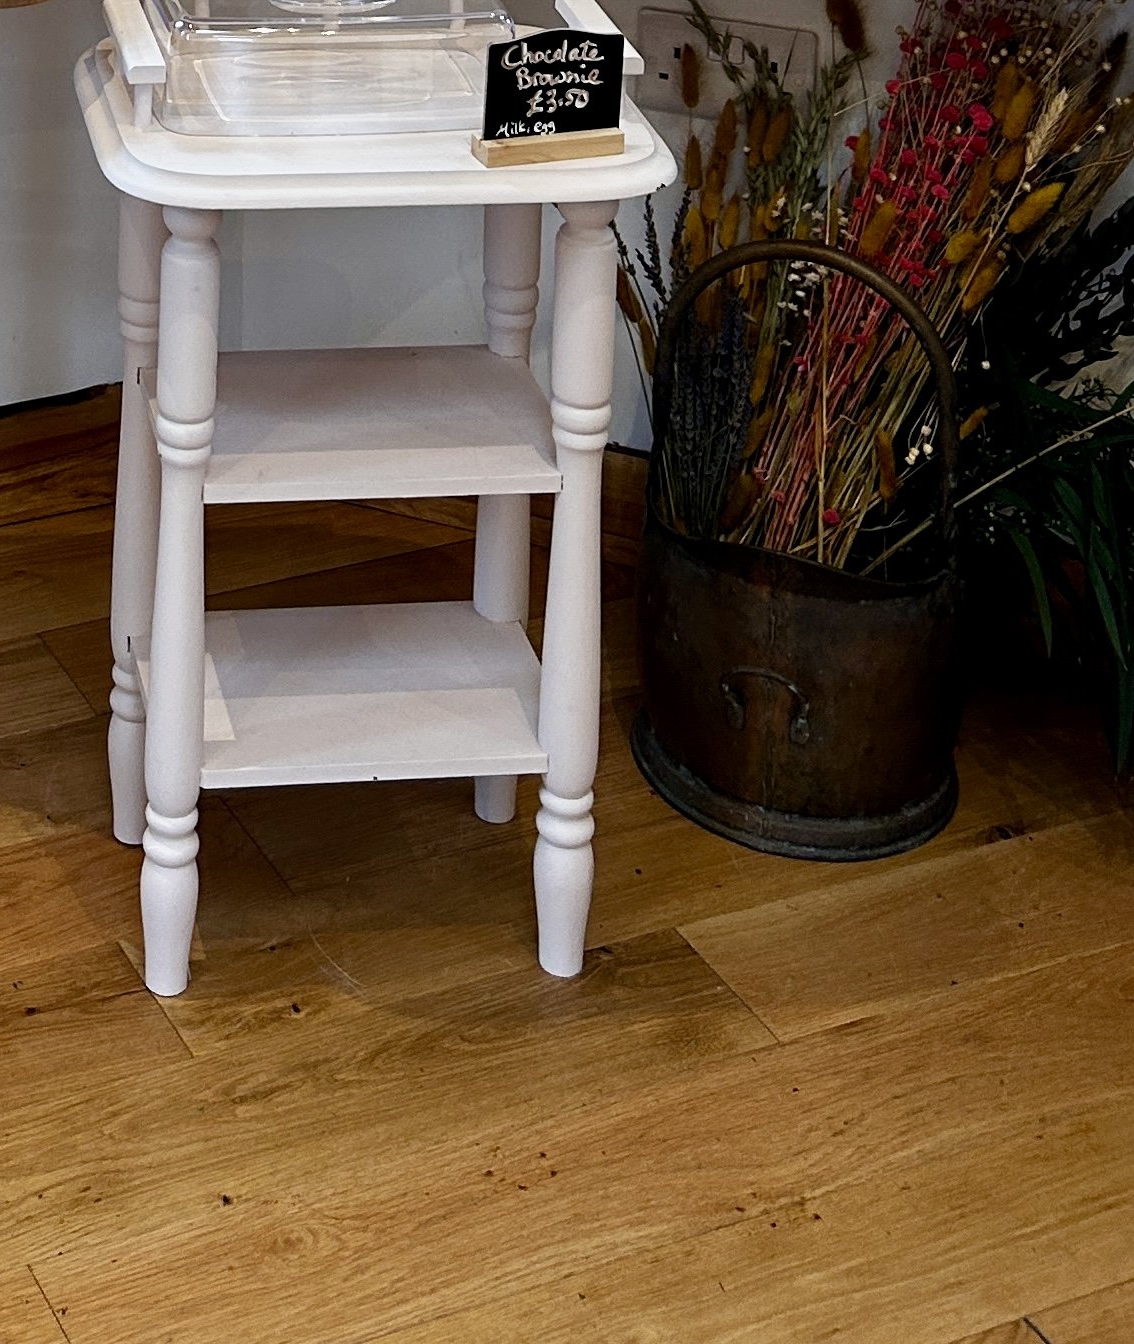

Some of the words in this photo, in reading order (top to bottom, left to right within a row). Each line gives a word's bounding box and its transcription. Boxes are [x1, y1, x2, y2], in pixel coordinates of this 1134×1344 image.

[501, 40, 605, 70] Chocolate
[516, 64, 604, 90] Brownie
[526, 88, 590, 117] £3.50
